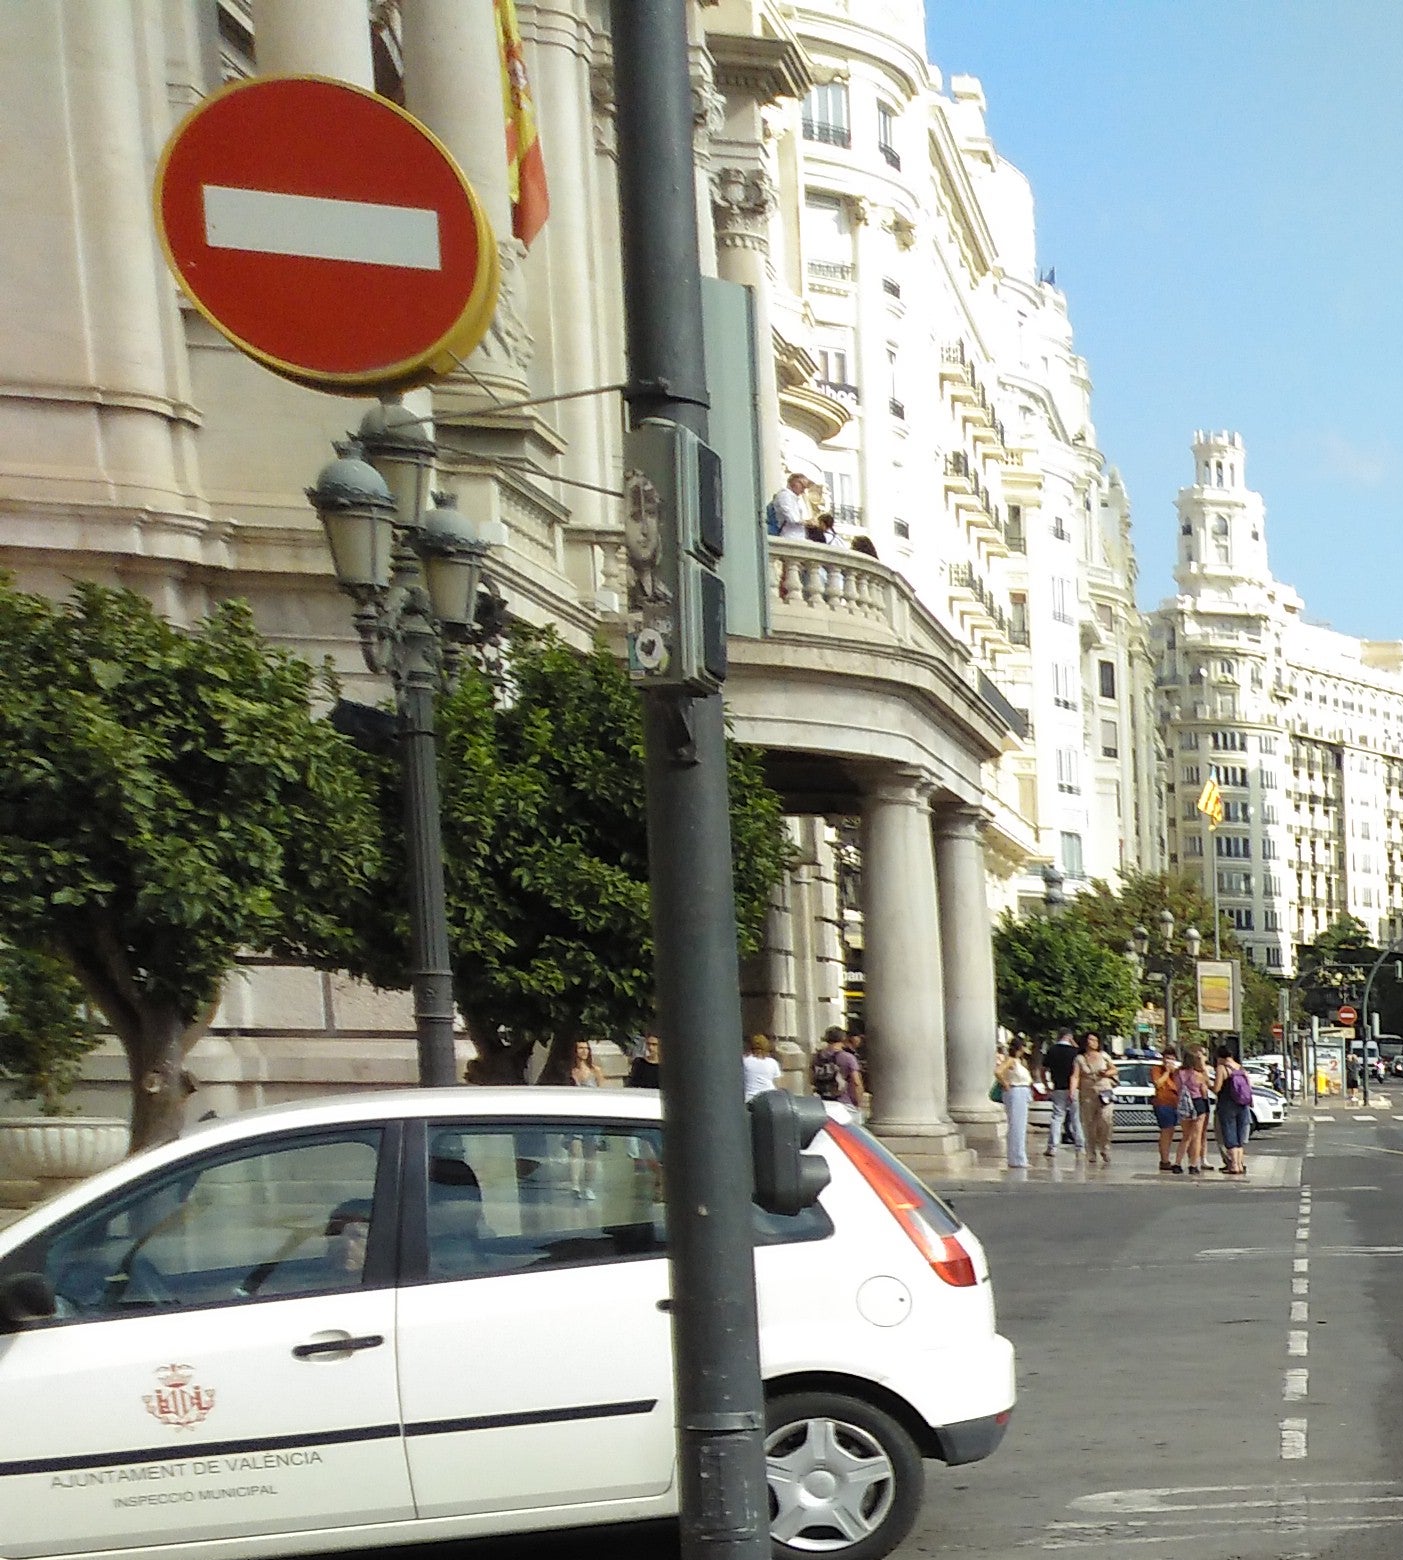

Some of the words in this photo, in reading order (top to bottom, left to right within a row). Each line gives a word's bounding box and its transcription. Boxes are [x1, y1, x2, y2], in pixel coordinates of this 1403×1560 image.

[51, 1463, 187, 1488] AJUNTAMENT
[193, 1460, 221, 1475] DE
[199, 1484, 279, 1501] MUNICIPAL
